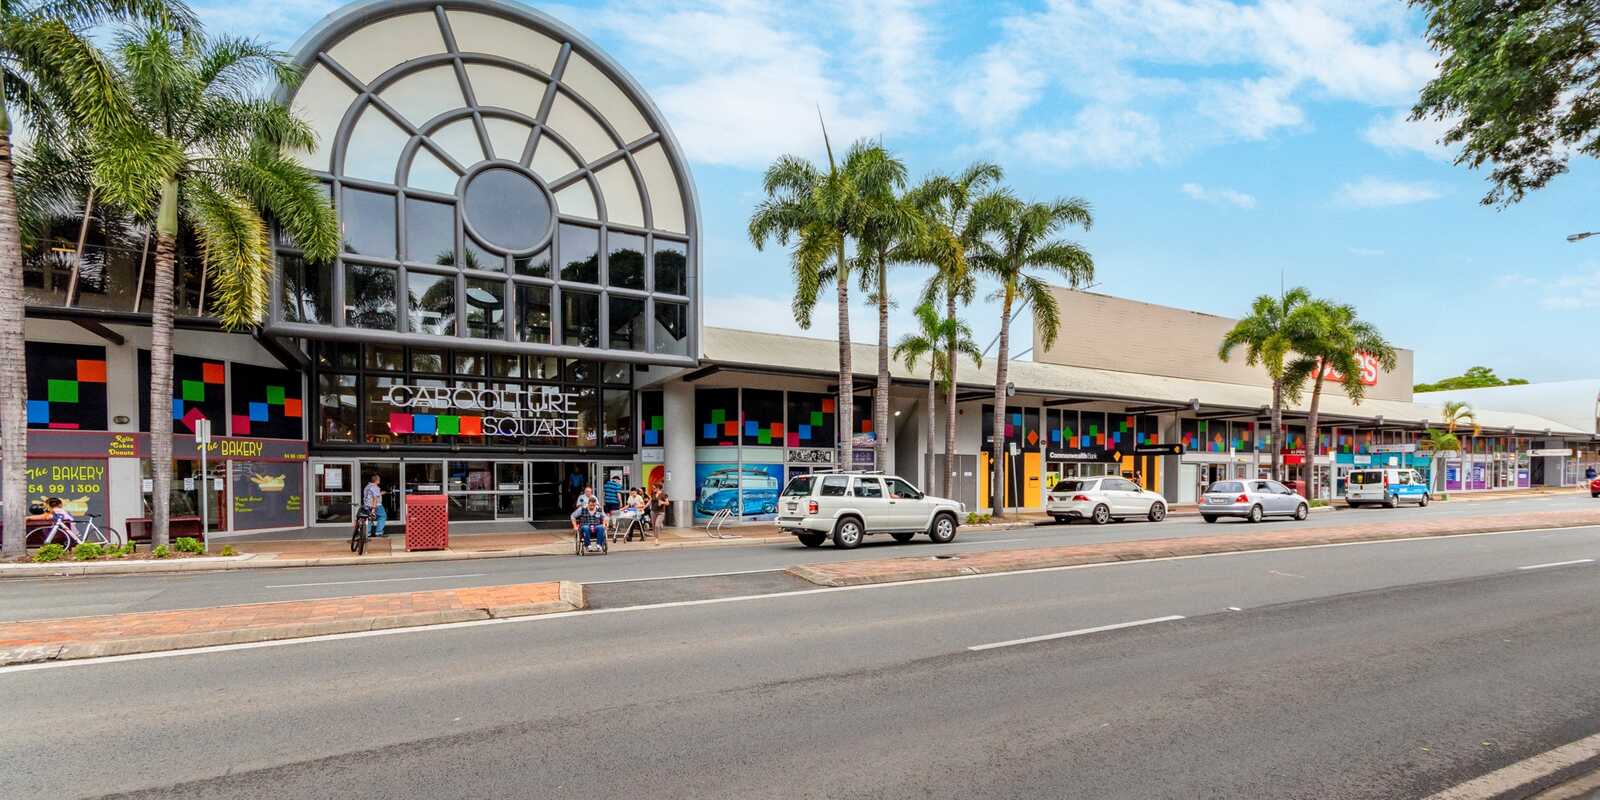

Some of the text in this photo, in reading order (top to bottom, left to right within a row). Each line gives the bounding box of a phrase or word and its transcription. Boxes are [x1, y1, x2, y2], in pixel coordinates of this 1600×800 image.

[388, 385, 579, 414] CABOOLTURE
[482, 415, 579, 438] SQUARE
[221, 440, 263, 457] BAKERY
[25, 465, 104, 481] The BAKERY
[28, 484, 100, 493] 54 99 1300
